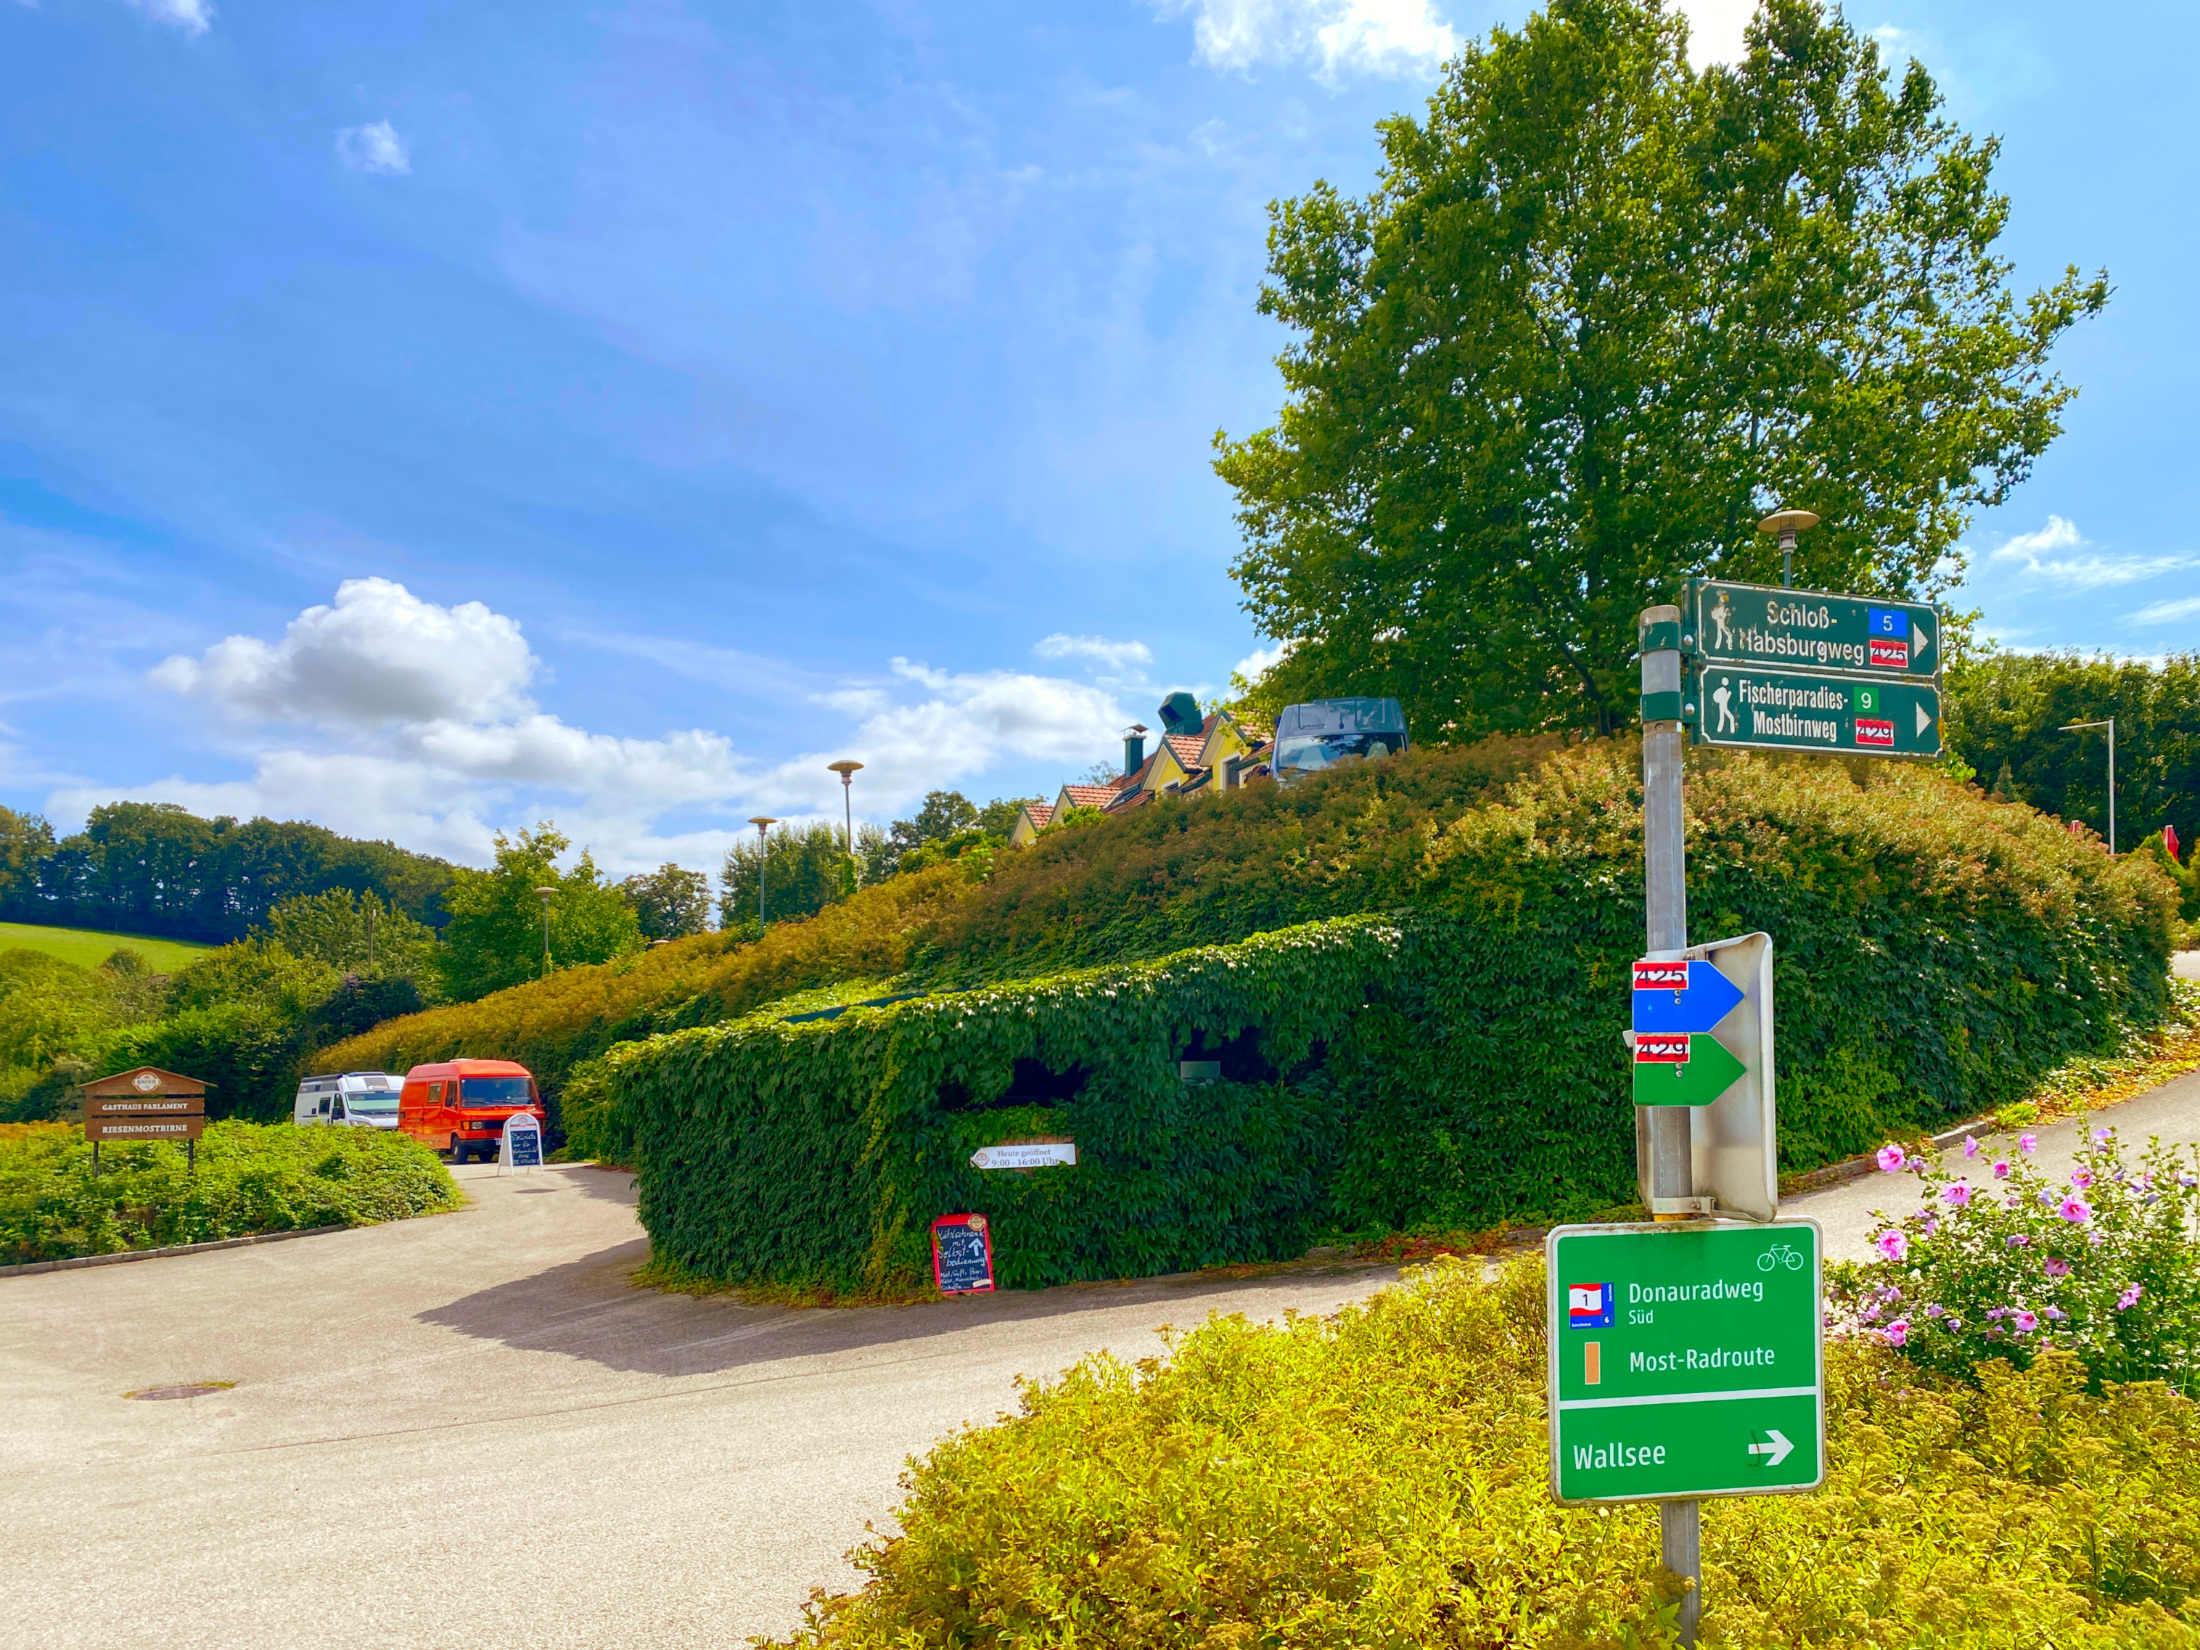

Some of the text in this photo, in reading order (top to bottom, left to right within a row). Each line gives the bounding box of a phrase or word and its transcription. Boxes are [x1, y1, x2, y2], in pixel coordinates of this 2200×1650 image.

[1766, 600, 1838, 629] Schloß-
[1882, 615, 1893, 632] 5
[1739, 627, 1865, 666] Habsburgweg
[1871, 644, 1906, 663] 425
[1739, 679, 1849, 710] Fischerparadies-
[1860, 692, 1873, 709] 9
[1752, 710, 1838, 742] Mostbirnweg
[1857, 723, 1892, 742] 429
[1636, 967, 1686, 985] 425
[1638, 1040, 1687, 1058] 429
[102, 1124, 188, 1133] RIESENMOSTBIRNE
[991, 1159, 1010, 1167] 9:00
[1018, 1158, 1040, 1166] 16:00
[1042, 1157, 1060, 1166] Uhr
[1021, 1148, 1051, 1158] geöffnet
[946, 1257, 986, 1267] bedienung
[1582, 1293, 1589, 1306] 1
[1629, 1279, 1764, 1303] Donauradweg
[1604, 1316, 1610, 1324] 6
[1629, 1309, 1654, 1325] Süd
[1629, 1346, 1775, 1373] Most-Radroute
[1573, 1442, 1666, 1470] Wallsee
